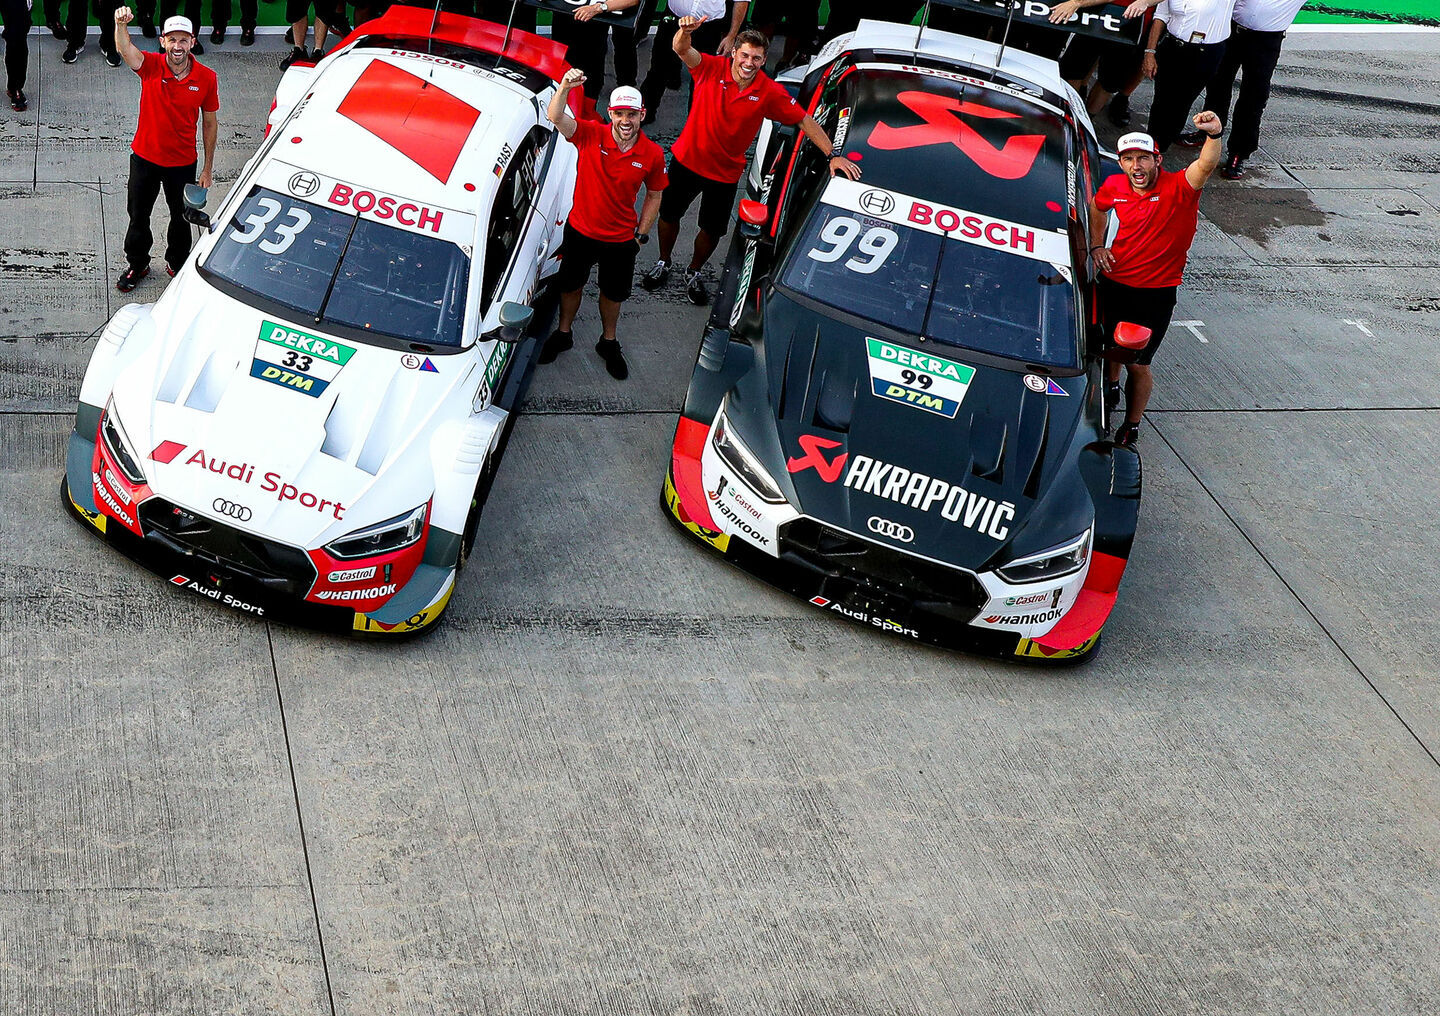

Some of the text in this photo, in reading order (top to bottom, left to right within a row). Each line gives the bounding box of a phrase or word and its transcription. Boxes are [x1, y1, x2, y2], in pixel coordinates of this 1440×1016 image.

[391, 50, 465, 70] BOSCH
[902, 65, 985, 86] BOSCH
[498, 142, 514, 169] RAST
[328, 183, 444, 233] BOSCH
[229, 197, 312, 255] 33
[908, 201, 1035, 253] BOSCH
[808, 216, 899, 274] 99
[270, 327, 340, 361] DEKRA
[282, 351, 313, 372] 33
[488, 340, 508, 384] DEKR
[880, 345, 962, 380] DEKRA
[262, 366, 314, 391] DTM
[901, 369, 933, 390] 99
[885, 385, 944, 411] DTM
[110, 478, 130, 504] Castrol
[185, 449, 346, 521] Audi Sport
[734, 494, 763, 520] Castrol
[340, 569, 373, 581] Castrol
[188, 582, 265, 616] Audi Sport
[1016, 592, 1048, 606] Castrol
[830, 602, 919, 638] Audi Sport
